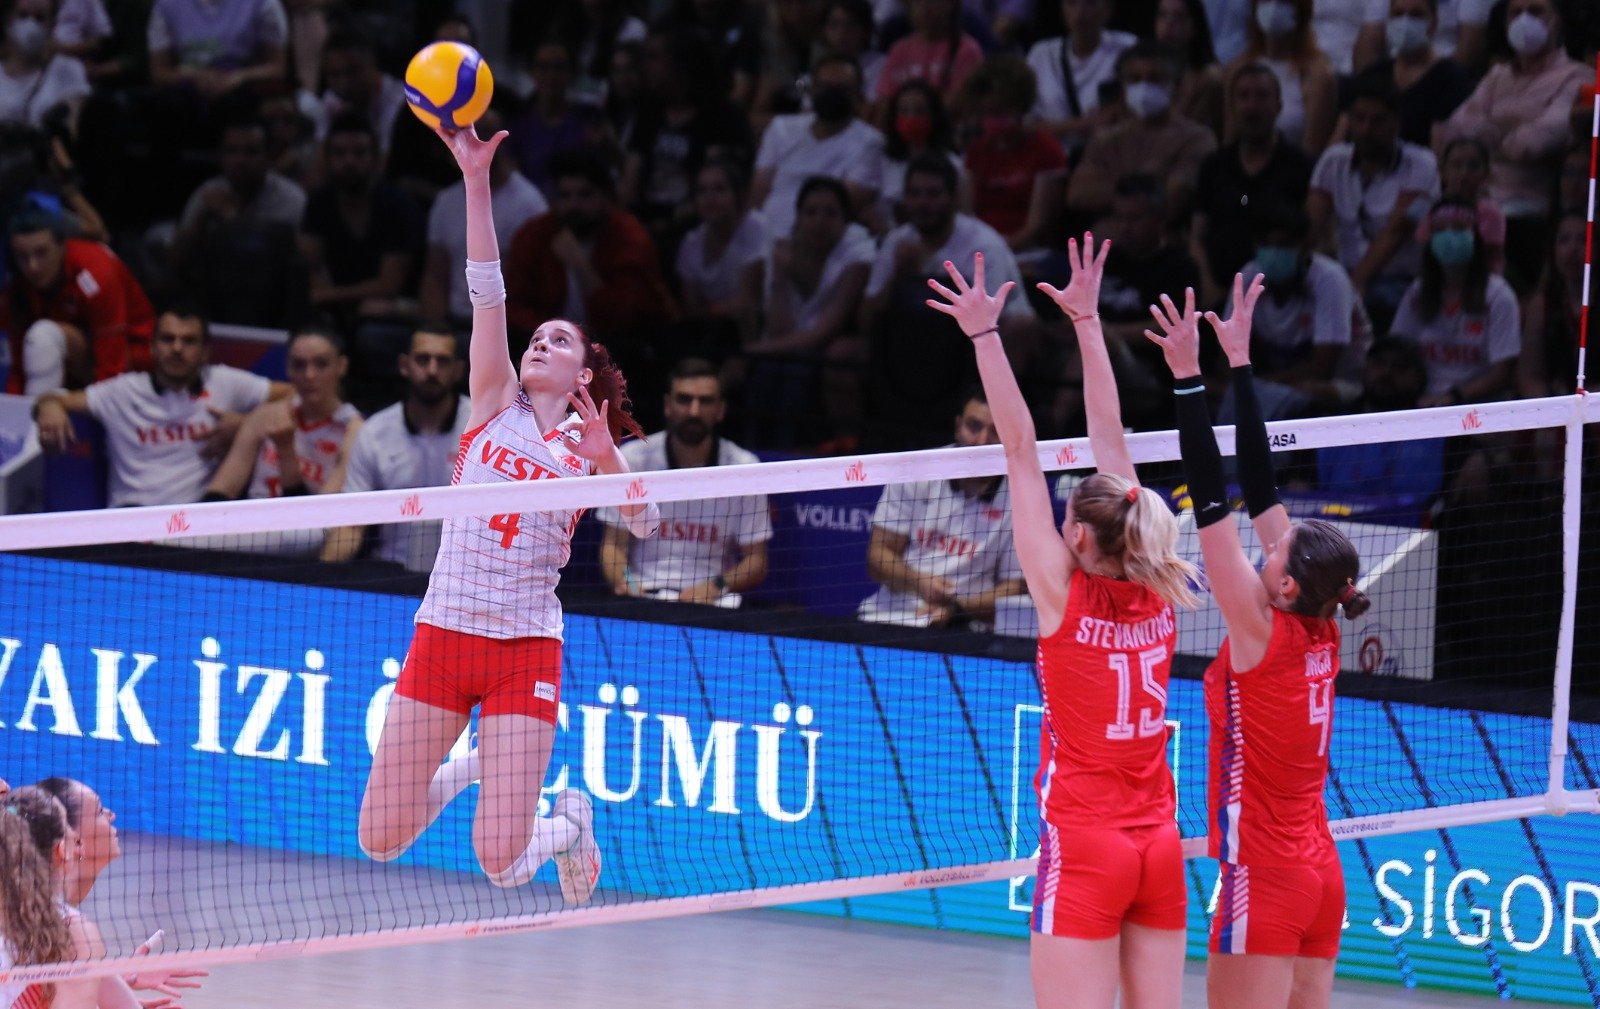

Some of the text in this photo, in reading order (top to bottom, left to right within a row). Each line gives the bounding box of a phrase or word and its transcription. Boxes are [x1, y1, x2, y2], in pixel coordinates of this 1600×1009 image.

[481, 439, 561, 481] VEST
[488, 512, 520, 550] 4
[660, 520, 720, 544] ESTEL
[191, 636, 333, 767] İZİ
[1105, 644, 1168, 740] 15
[1308, 678, 1333, 757] 4
